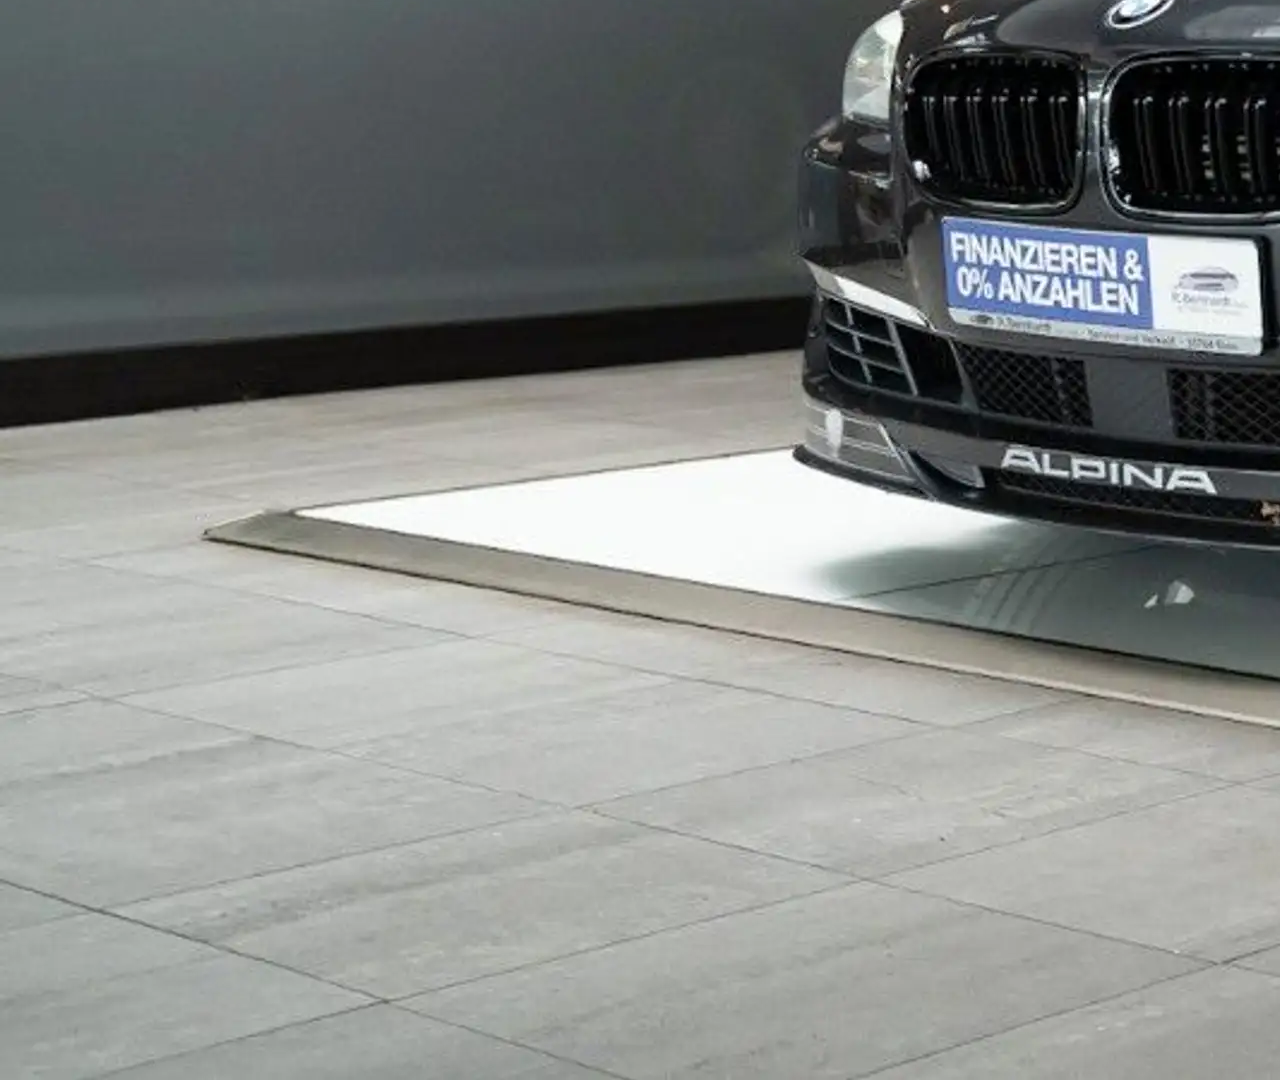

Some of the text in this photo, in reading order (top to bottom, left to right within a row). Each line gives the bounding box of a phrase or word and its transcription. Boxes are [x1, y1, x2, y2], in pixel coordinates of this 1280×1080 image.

[950, 231, 1144, 281] FINANZIEREN &
[957, 267, 1139, 315] 0% ANZAHLEN
[1001, 447, 1217, 494] ALPINA
